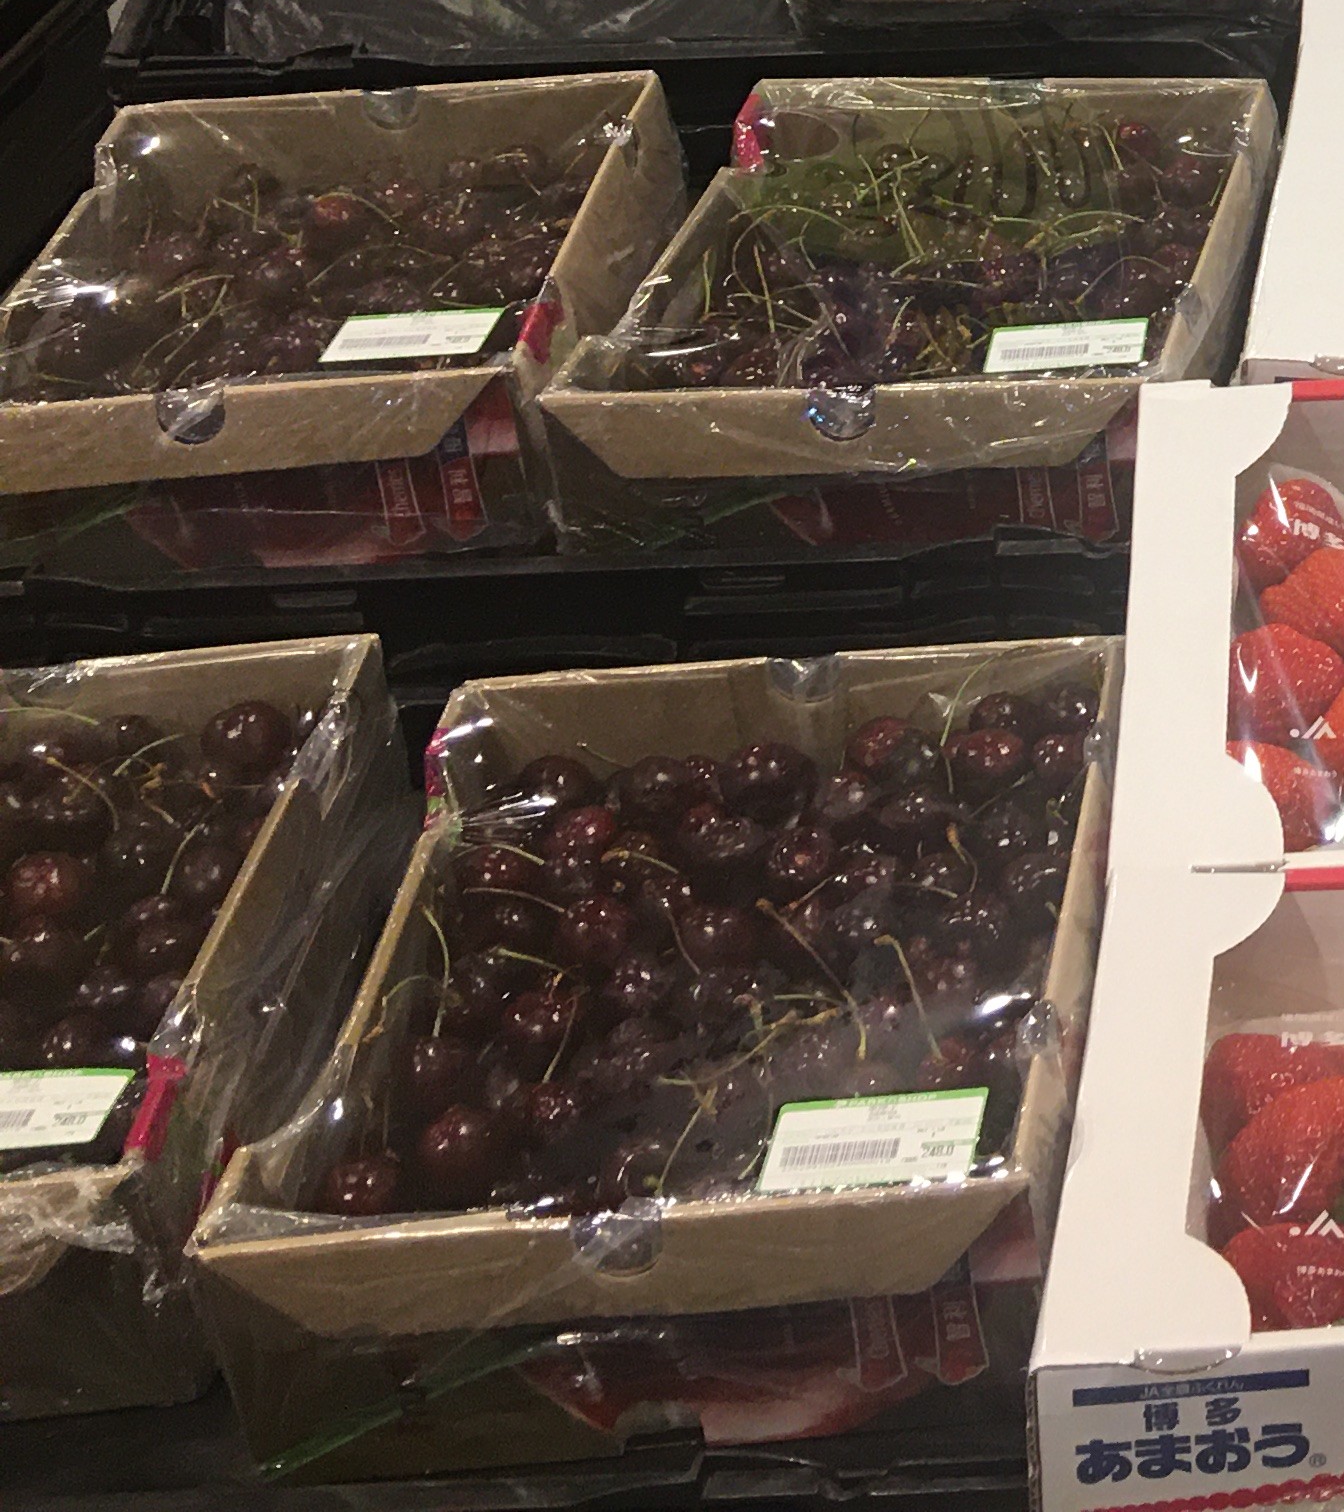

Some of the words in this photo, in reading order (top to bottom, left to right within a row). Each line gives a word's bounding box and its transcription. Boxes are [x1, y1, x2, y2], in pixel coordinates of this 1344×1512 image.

[1143, 1396, 1242, 1433] 博多
[1075, 1422, 1311, 1485] あまおう
